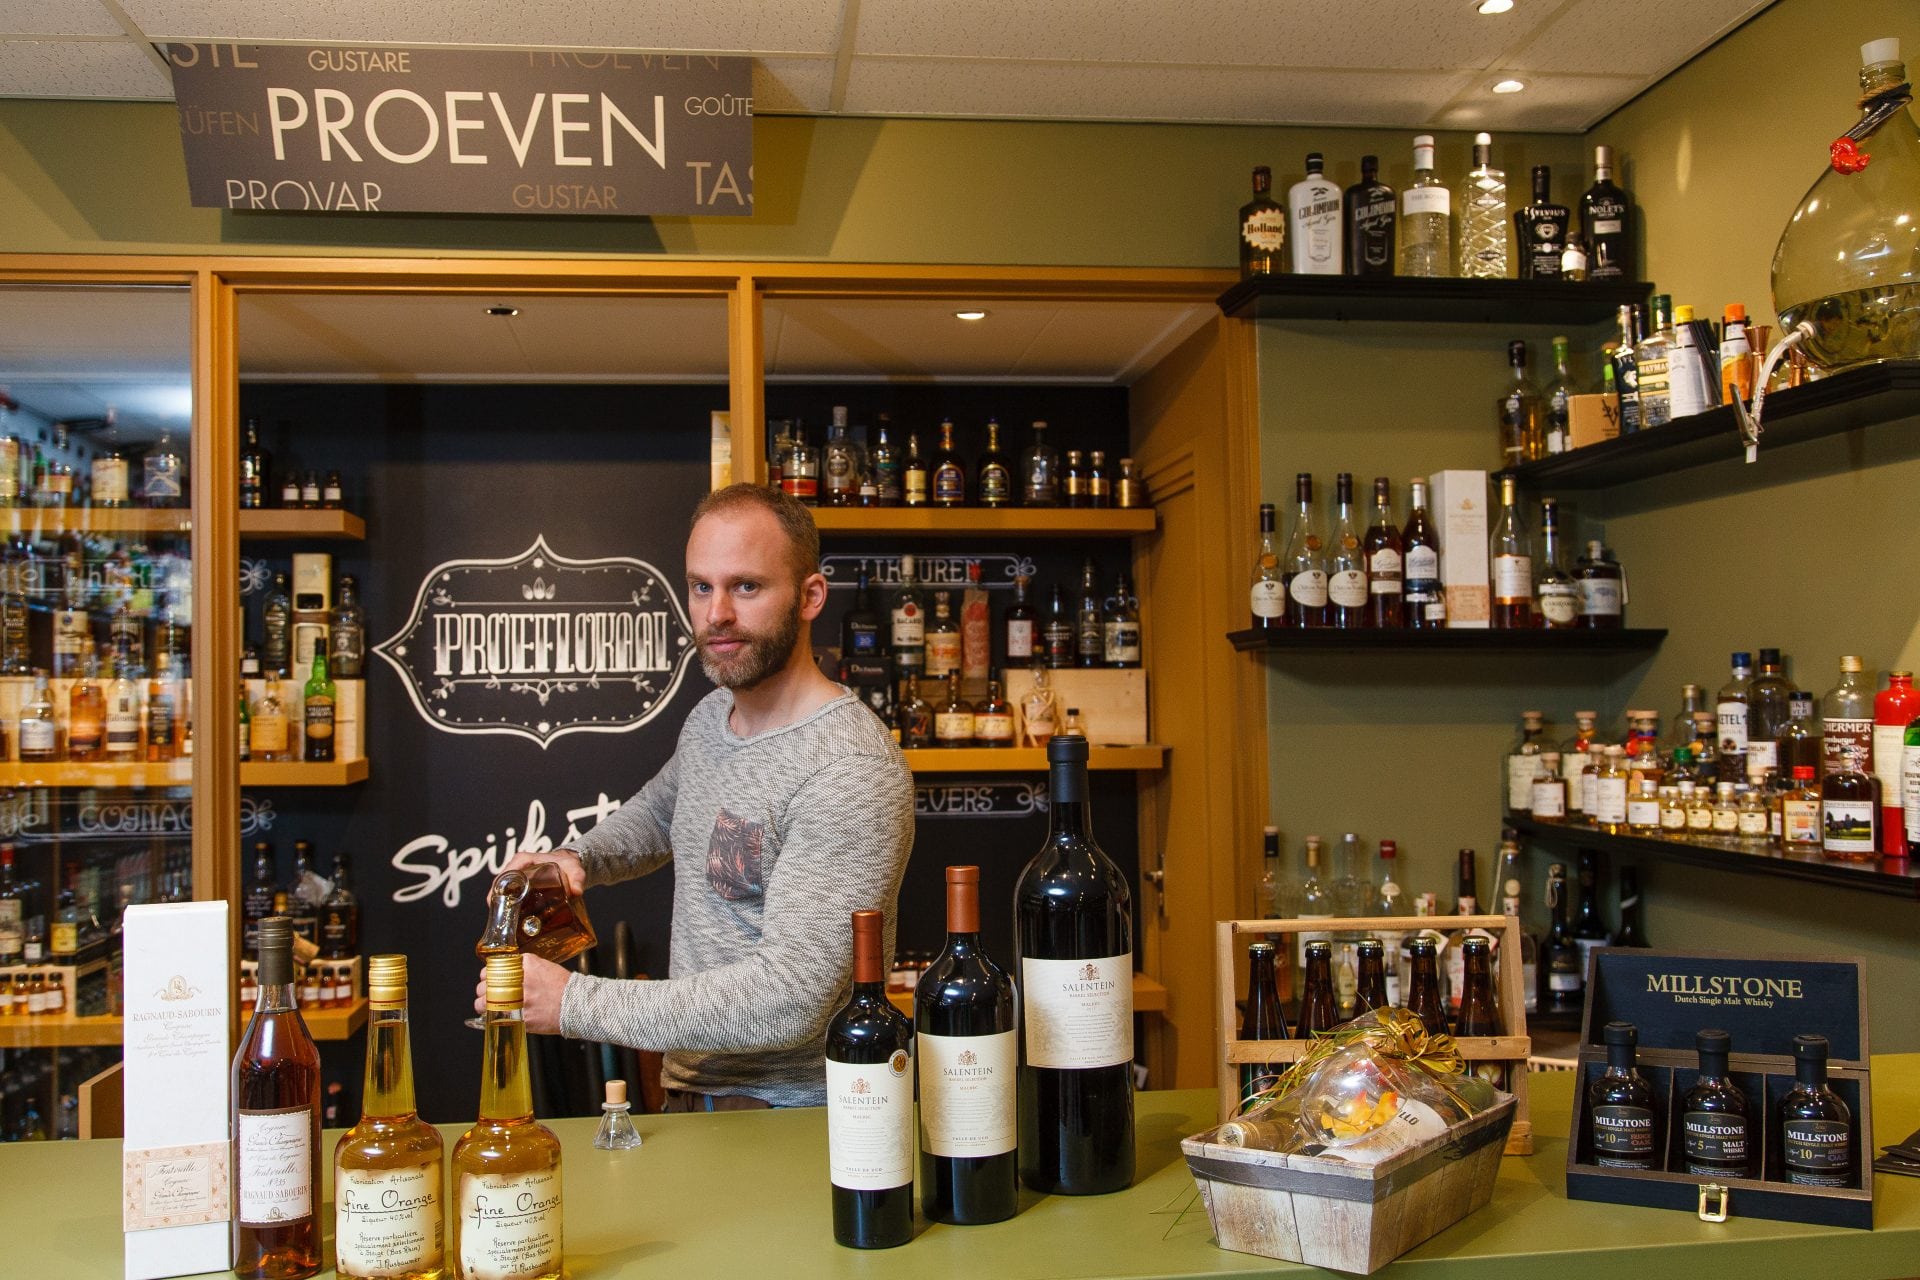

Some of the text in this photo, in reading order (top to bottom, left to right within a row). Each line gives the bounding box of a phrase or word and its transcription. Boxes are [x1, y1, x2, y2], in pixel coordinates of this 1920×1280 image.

[308, 50, 411, 73] GUSTARE
[266, 86, 666, 170] PROEVEN
[225, 179, 383, 211] PROVAR
[512, 183, 618, 210] GUSTAR
[1247, 222, 1283, 235] Holland
[432, 611, 672, 676] PROEFLOKAAL
[1062, 980, 1116, 992] SALENTEIN
[1646, 973, 1804, 999] MILLSTONE
[1674, 994, 1775, 1009] Dutch Single Malt Whisky
[132, 1008, 222, 1022] RAGNAUD-SABOURIN
[943, 1066, 993, 1076] SALENTEIN
[838, 1095, 889, 1105] SALENTEIN
[1594, 1115, 1652, 1128] MILLSTONE
[1686, 1121, 1745, 1136] MILLSTONE
[1605, 1132, 1616, 1144] 10
[1787, 1129, 1849, 1143] MILLSTONE
[1697, 1140, 1704, 1150] 5
[1722, 1140, 1745, 1148] MALT
[1800, 1148, 1813, 1160] 10
[344, 1189, 434, 1223] fine Orange
[474, 1192, 560, 1230] fine Orange
